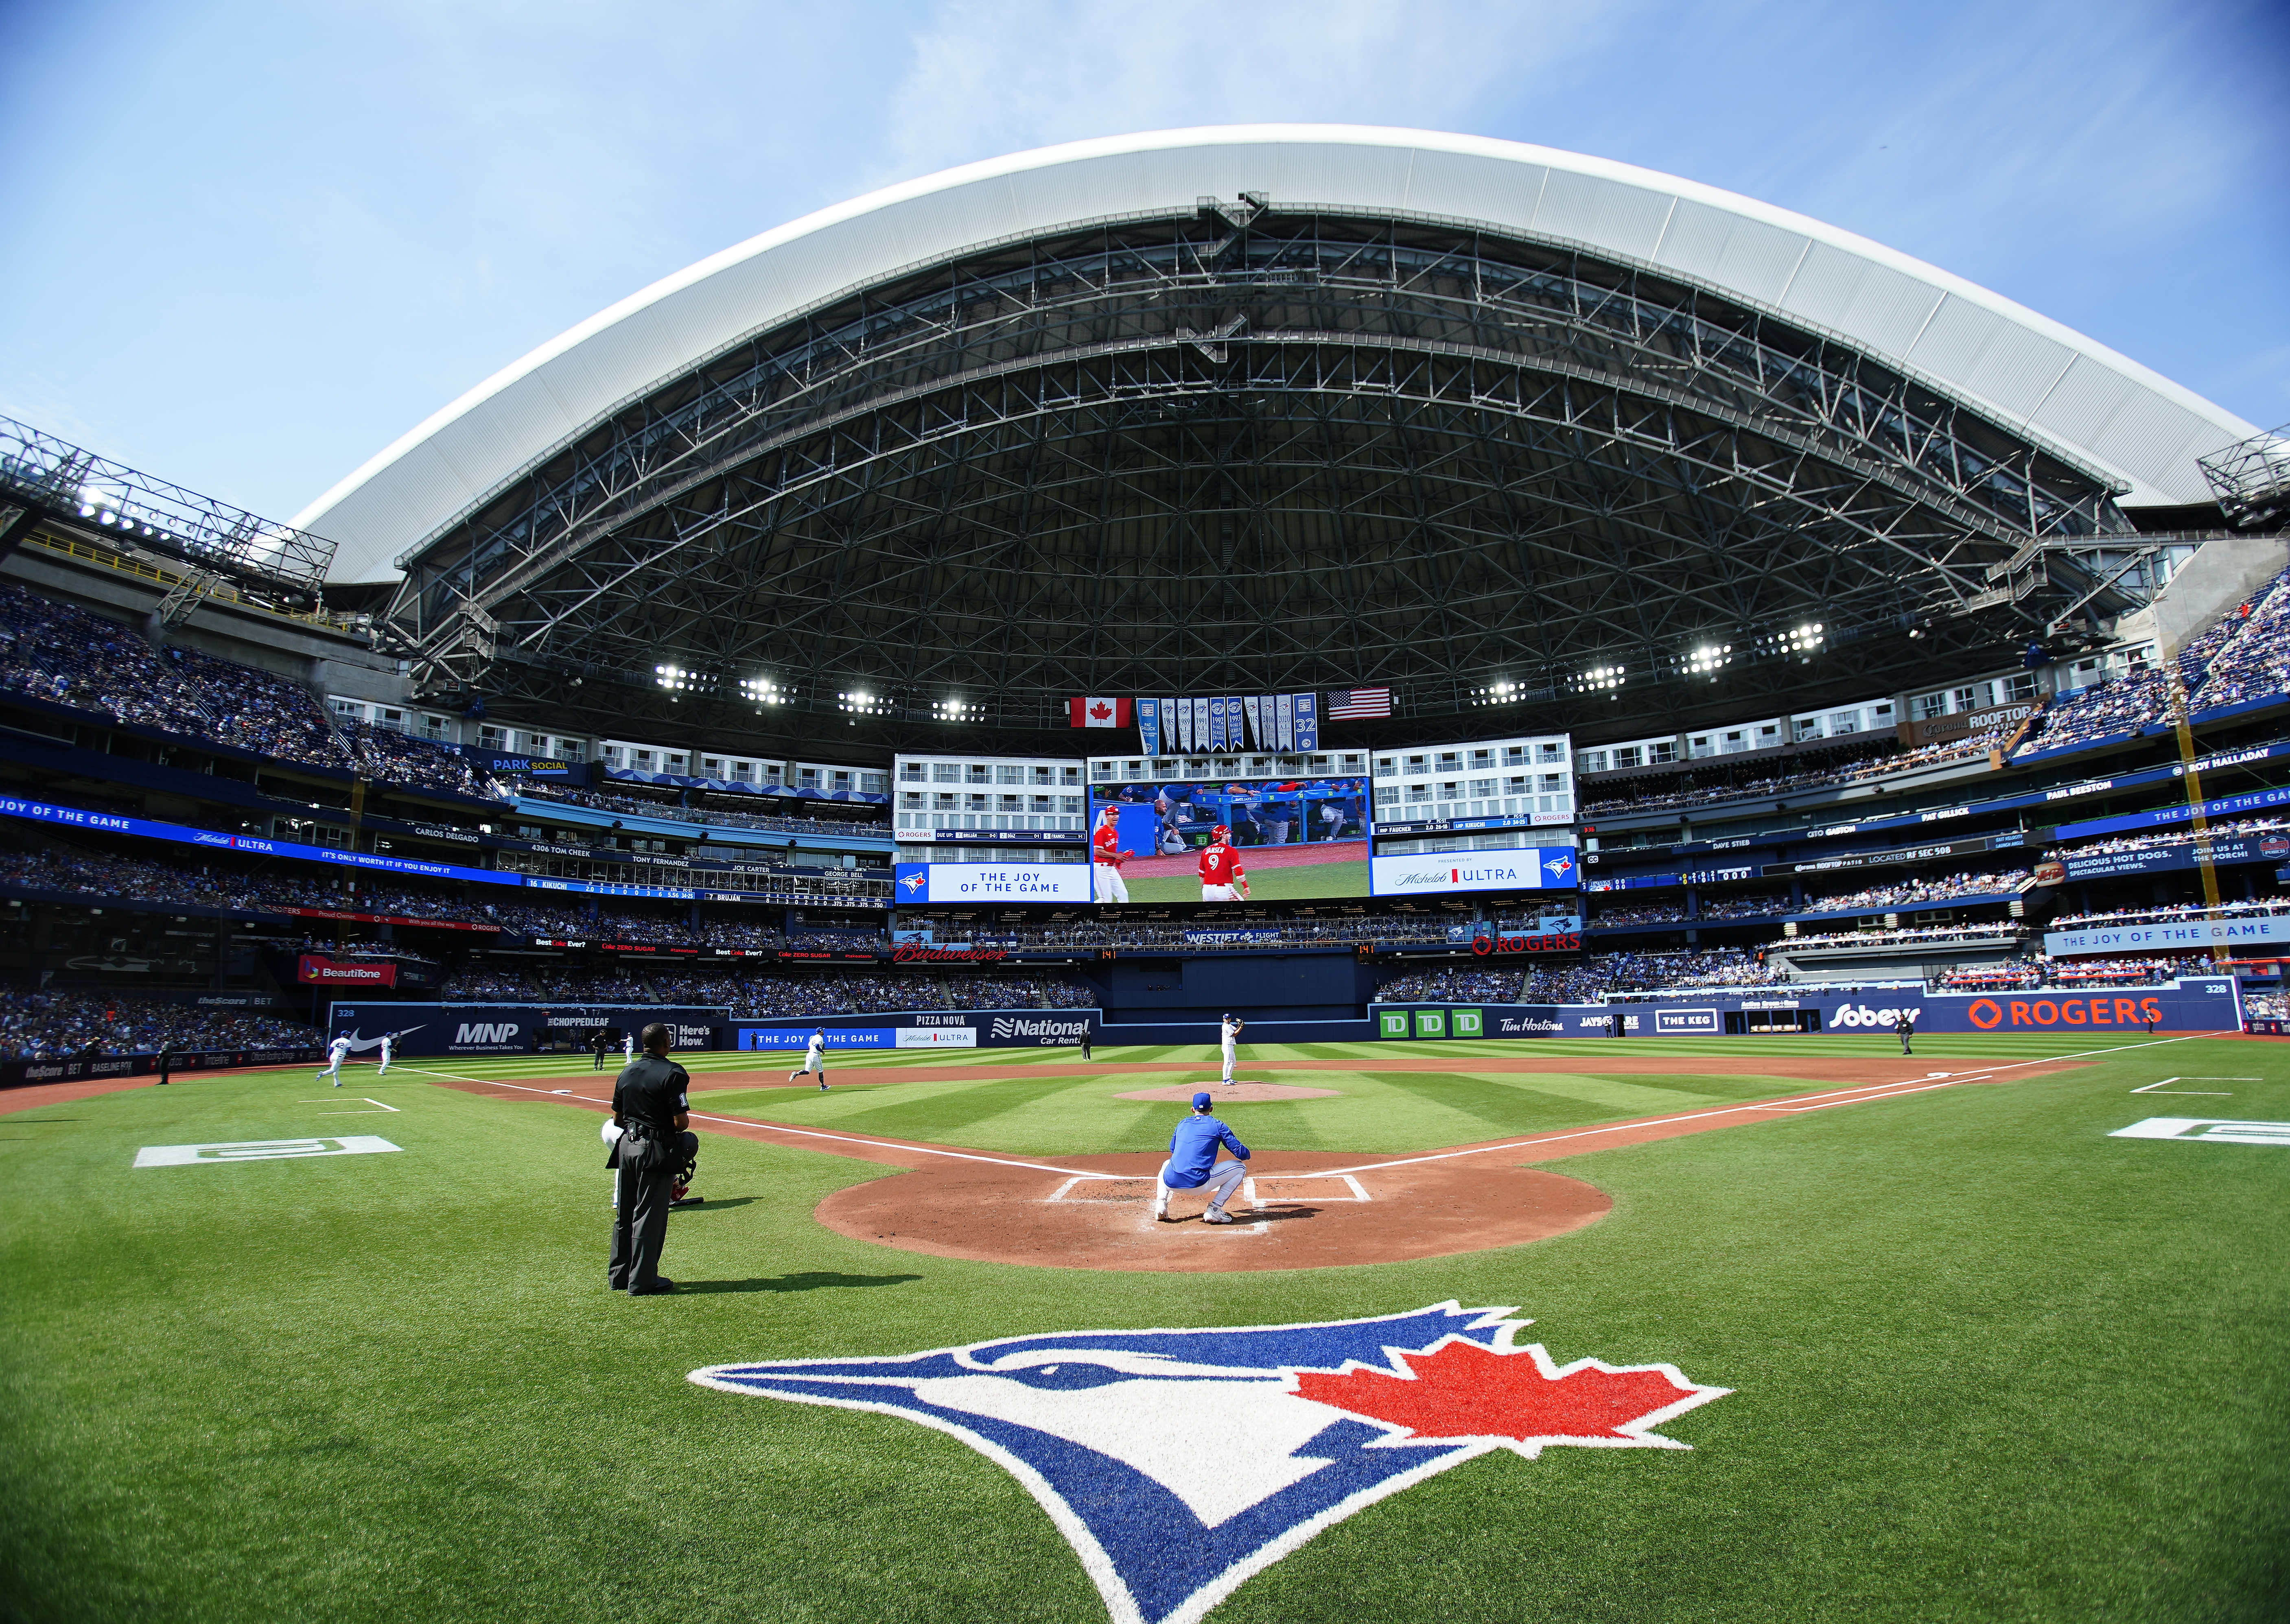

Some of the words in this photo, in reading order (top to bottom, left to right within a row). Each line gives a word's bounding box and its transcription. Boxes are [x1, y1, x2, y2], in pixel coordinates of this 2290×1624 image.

[1969, 705, 2032, 729] ROOFTOP
[1296, 718, 1316, 732] 32
[1923, 721, 1968, 738] Corona
[1987, 721, 2015, 731] PATIO
[493, 760, 530, 770] PARK
[531, 761, 567, 769] SOCIAL
[2188, 761, 2210, 773] ROY
[2212, 748, 2269, 768] HALLADAY
[2046, 789, 2069, 801] PAUL
[2070, 781, 2112, 796] BEESTON
[2154, 810, 2178, 821] THE
[2183, 805, 2207, 817] JOY
[2212, 802, 2229, 811] OF
[2234, 796, 2261, 807] THE
[2266, 791, 2290, 802] GA
[32, 806, 51, 816] OF
[57, 810, 83, 822] THE
[90, 816, 130, 829] GAME
[1921, 812, 1936, 822] PAT
[1938, 807, 1969, 820] GILLICK
[416, 827, 444, 838] CARLOS
[446, 832, 479, 843] DELGADO
[1807, 830, 1824, 838] CITO
[1825, 825, 1856, 835] GASTON
[238, 839, 273, 851] ULTRA
[1205, 846, 1225, 855] JANSEN
[1713, 842, 1729, 850] DAVE
[1731, 839, 1750, 848] STIEB
[569, 848, 590, 857] CHEEK
[1868, 853, 1906, 863] LOCATED
[1906, 850, 1917, 859] RF
[1918, 848, 1933, 858] SEC
[2192, 847, 2214, 855] JOIN
[2212, 851, 2248, 860] PORCH!
[338, 852, 356, 862] ONLY
[358, 856, 384, 866] WORTH
[404, 862, 418, 870] YOU
[420, 864, 441, 873] ENJOY
[632, 856, 651, 864] TONY
[653, 857, 689, 867] FERNANDEZ
[1208, 855, 1219, 870] 9
[2068, 859, 2111, 870] DELICIOUS
[2114, 855, 2134, 863] HOT
[2137, 850, 2172, 861] DOGS.
[1014, 873, 1040, 881] JOY
[1395, 872, 1448, 886] Michelob
[1463, 869, 1517, 881] ULTRA
[2069, 866, 2115, 877] SPECTACULAR
[542, 881, 567, 890] KIKUCHI
[1019, 884, 1059, 892] GAME
[717, 894, 740, 902] BRUJÁN
[2064, 936, 2085, 946] THE
[2093, 933, 2121, 945] JOY
[2131, 931, 2153, 942] OF
[2163, 928, 2200, 940] THE
[2211, 924, 2270, 937] GAME
[1360, 945, 1374, 953] 1:41
[1498, 933, 1580, 953] ROGERS
[889, 942, 1007, 962] Budweiser
[1102, 951, 1115, 959] 1:41
[323, 968, 381, 979] BeautiTone
[2205, 985, 2227, 994] 328
[197, 997, 247, 1005] theScore
[2010, 997, 2162, 1025] ROGERS
[553, 1017, 609, 1027] CHOPPEDLEAF
[916, 1015, 941, 1025] PIZZA
[943, 1015, 965, 1025] NOVA
[1383, 1016, 1406, 1033] TD
[1418, 1015, 1443, 1032] TD
[1455, 1014, 1479, 1031] TD
[1500, 1018, 1522, 1032] Tim
[1580, 1017, 1603, 1027] JAYS
[1662, 1017, 1685, 1025] THE
[1688, 1016, 1710, 1025] KEG
[455, 1023, 519, 1043] MNP
[679, 1025, 710, 1035] Here's
[1014, 1019, 1089, 1036] National
[679, 1037, 704, 1046] How.
[851, 1034, 879, 1043] GAME
[903, 1034, 932, 1043] Michelob
[26, 1064, 62, 1079] theScore
[68, 1063, 82, 1075] BET
[92, 1062, 120, 1073] BASELINE
[679, 1093, 688, 1107] 1
